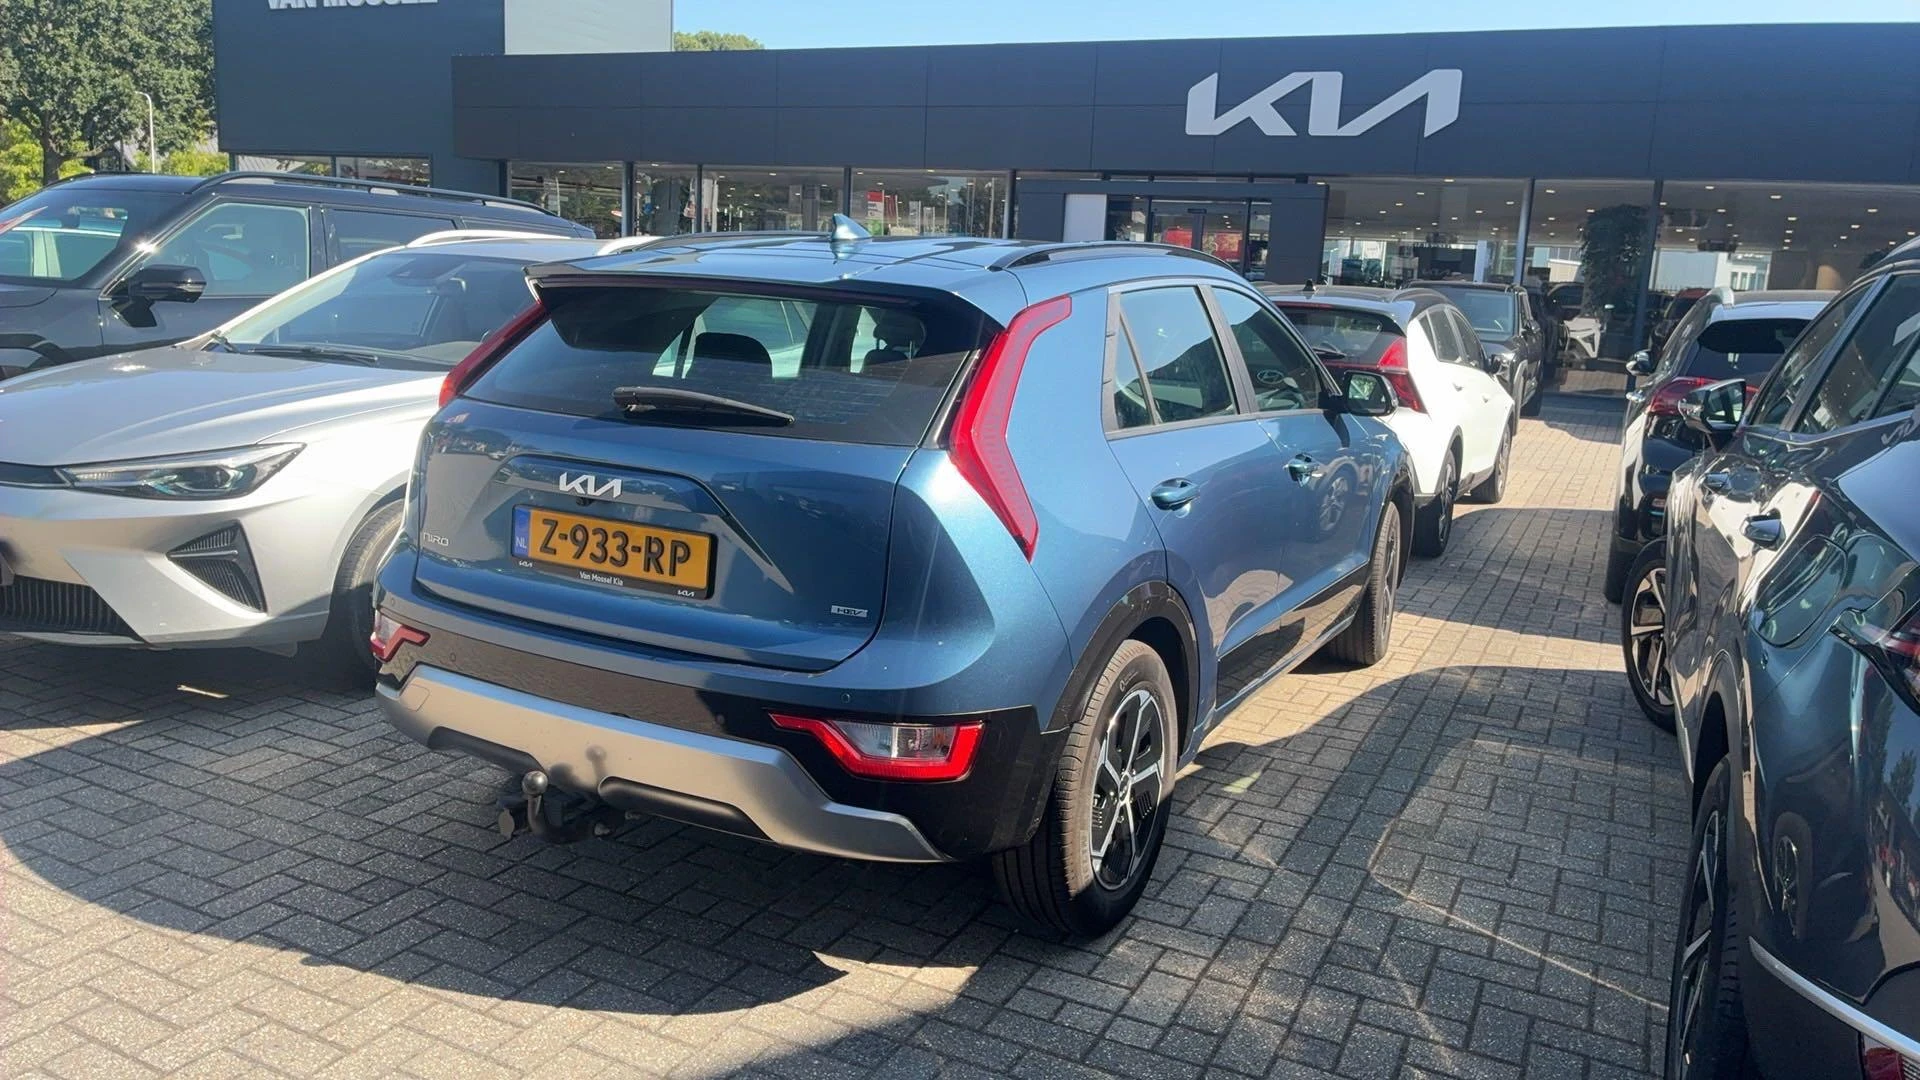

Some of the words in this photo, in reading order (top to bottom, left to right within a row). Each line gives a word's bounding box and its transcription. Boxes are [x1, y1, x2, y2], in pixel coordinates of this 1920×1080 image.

[1185, 68, 1463, 138] KIA
[559, 472, 622, 498] KIA
[423, 532, 449, 547] NIRO
[515, 536, 528, 549] NL
[539, 518, 691, 577] Z-933-RP
[580, 571, 591, 581] Van
[592, 573, 612, 584] Mossel
[613, 577, 624, 586] Kia
